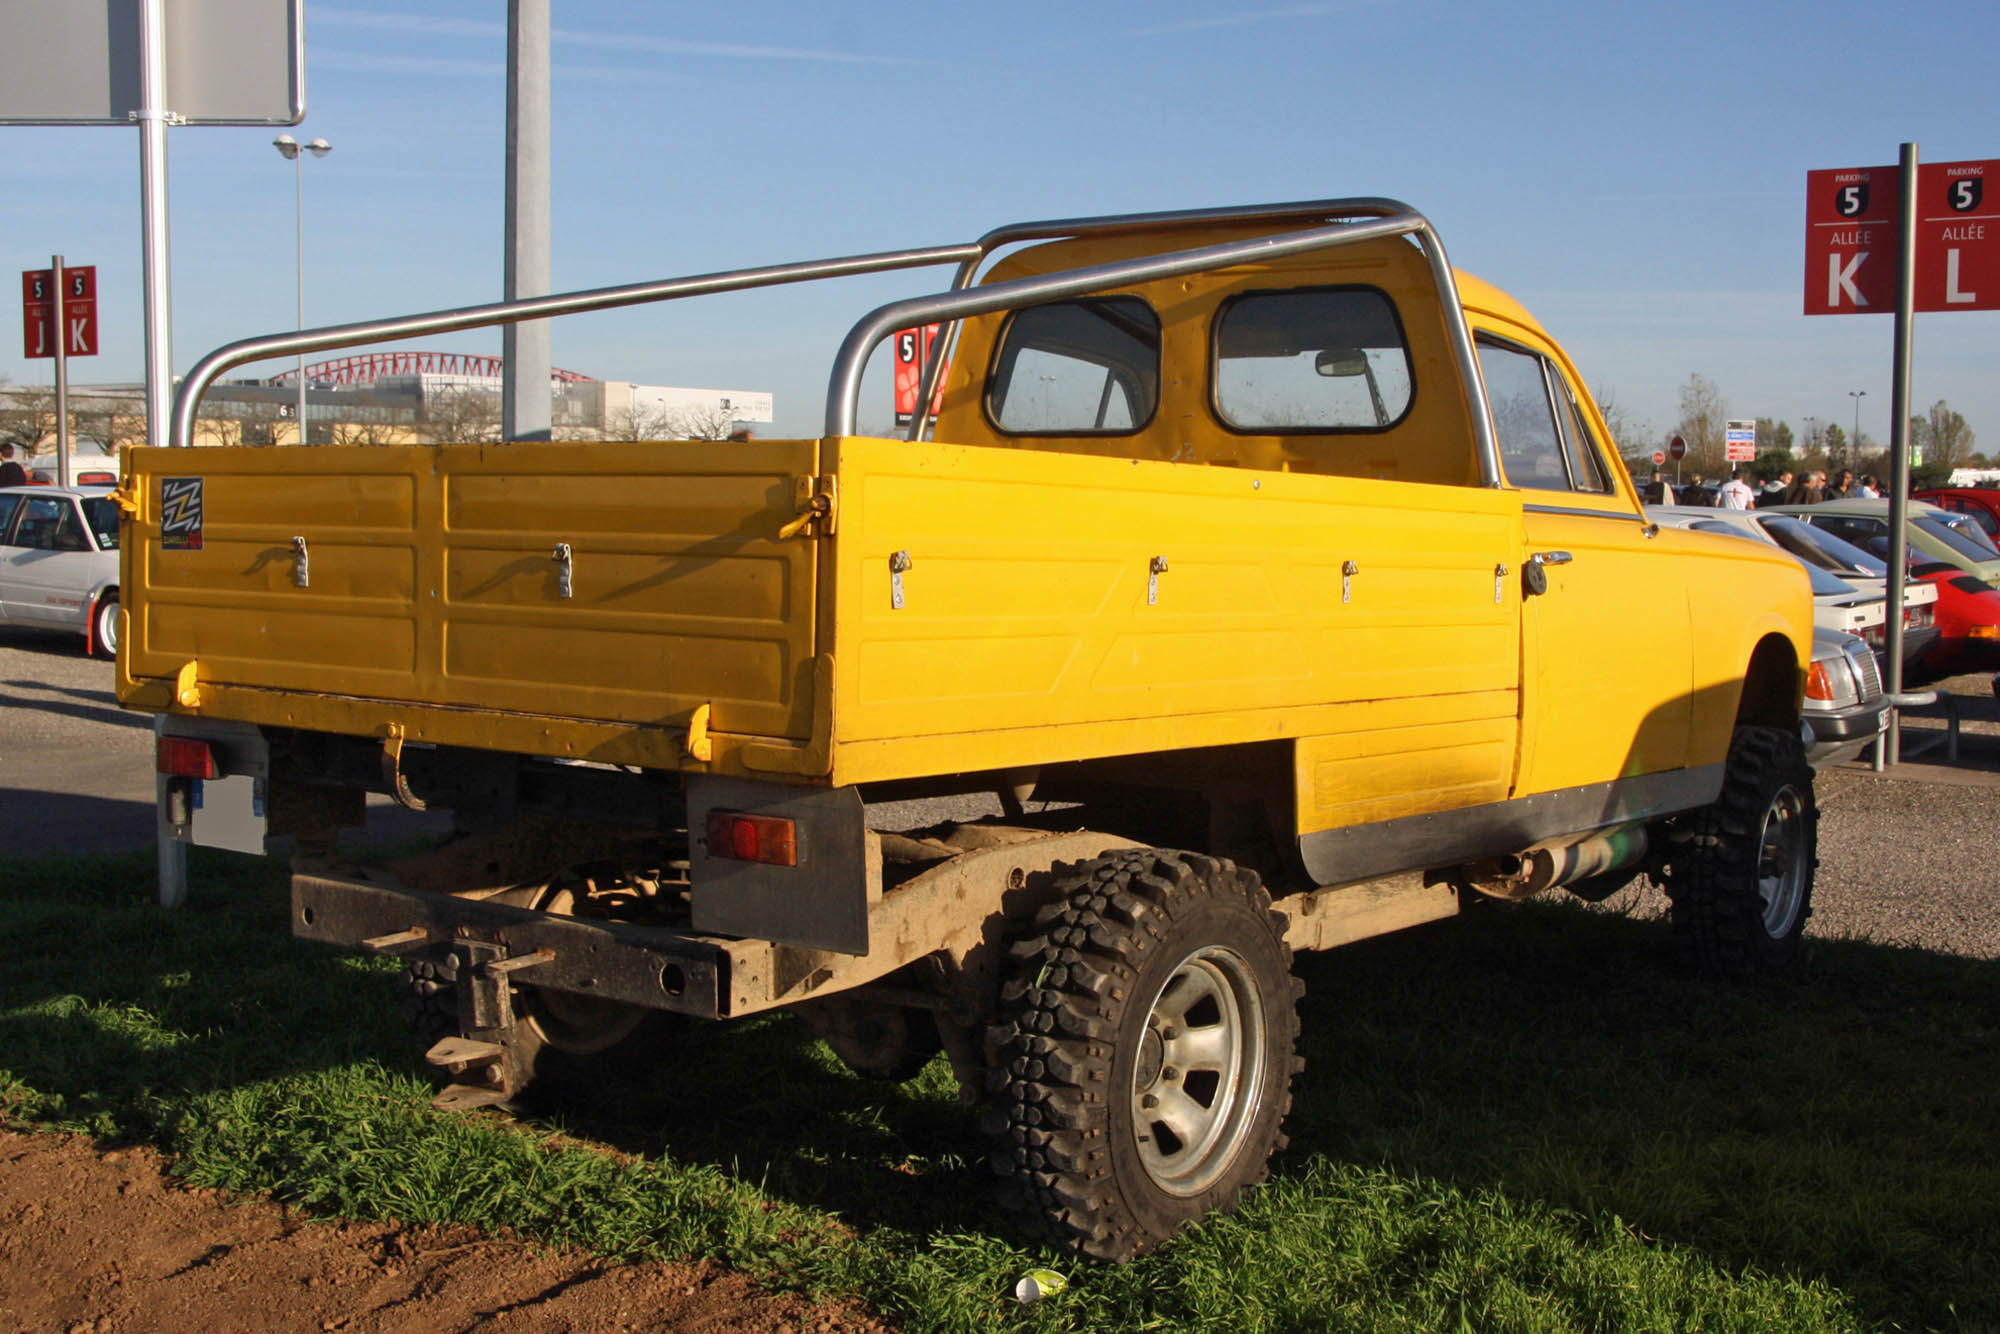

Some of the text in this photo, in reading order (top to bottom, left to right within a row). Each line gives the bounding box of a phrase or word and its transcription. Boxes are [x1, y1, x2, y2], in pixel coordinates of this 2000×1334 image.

[1947, 166, 1984, 176] PARKING
[1844, 186, 1860, 214] 5
[1956, 181, 1973, 209] 5
[1942, 224, 1985, 241] ALLÉE
[35, 281, 42, 299] 5
[75, 278, 83, 296] 5
[1828, 252, 1870, 307] K
[1946, 248, 1977, 304] L
[36, 320, 45, 354] J
[71, 318, 88, 352] K
[903, 334, 914, 362] 5
